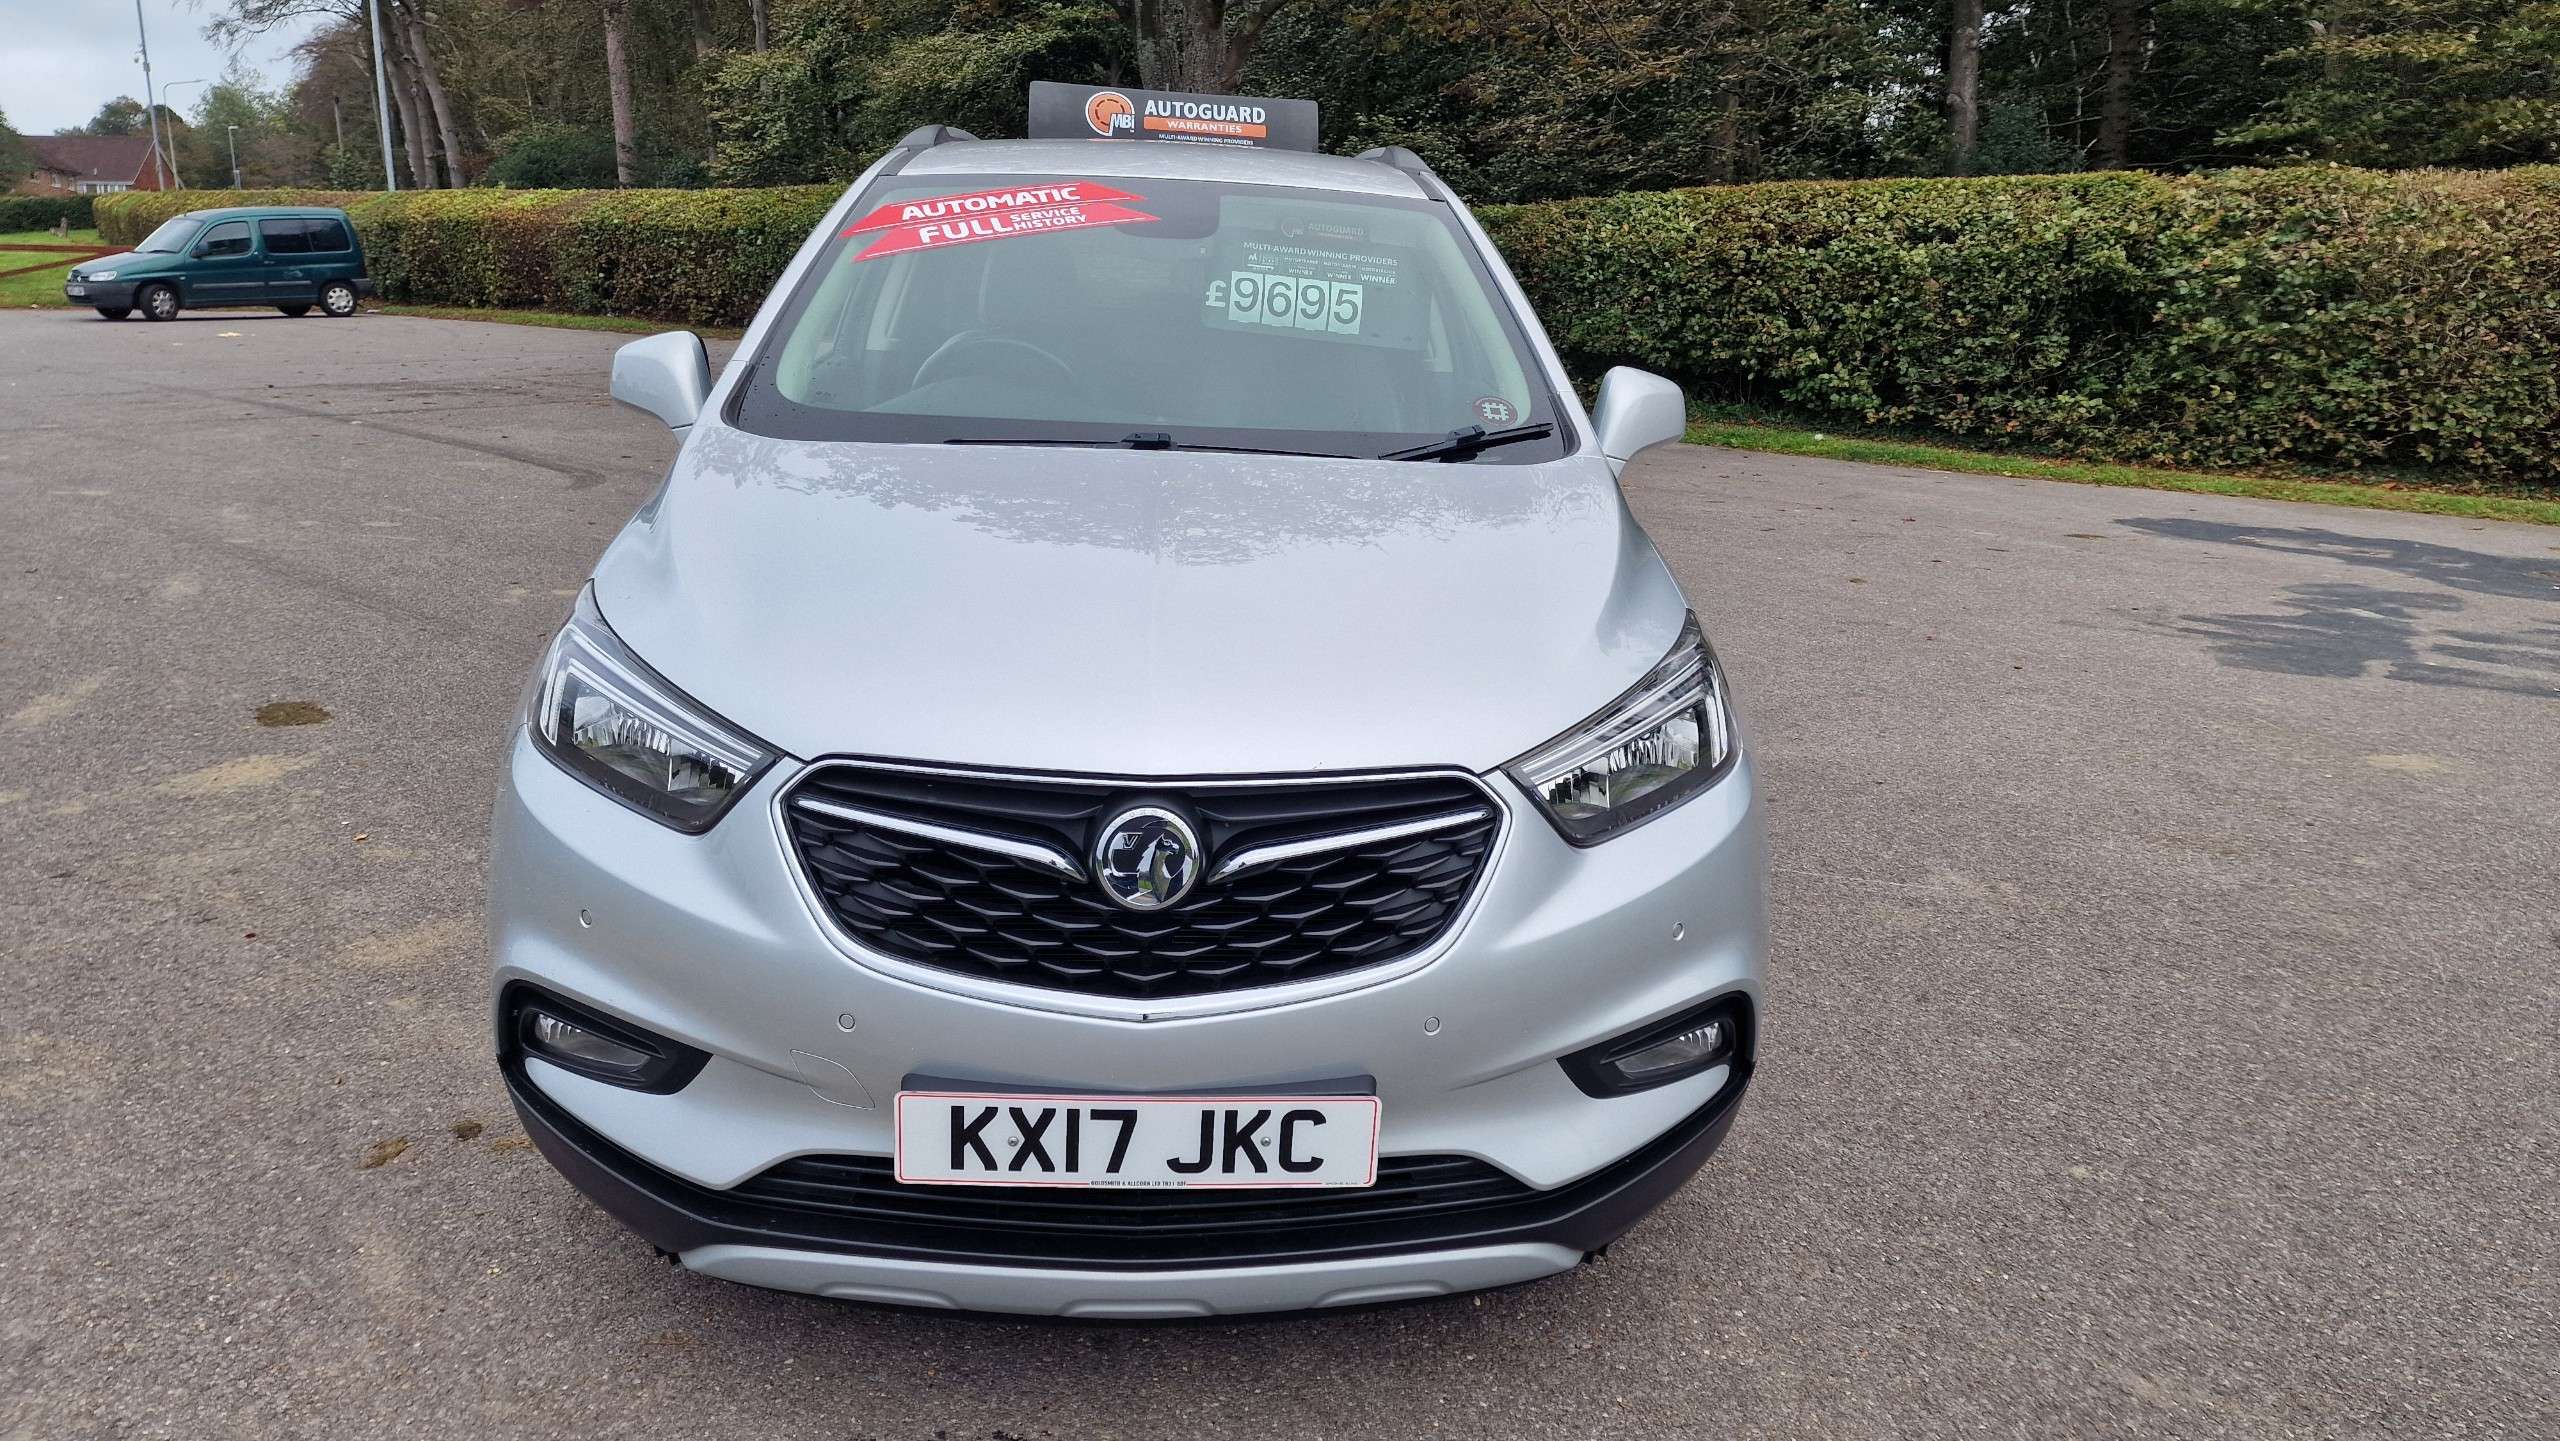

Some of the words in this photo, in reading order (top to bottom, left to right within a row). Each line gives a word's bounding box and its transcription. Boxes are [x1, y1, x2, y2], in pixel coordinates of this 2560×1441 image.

[1144, 99, 1267, 124] AUTOGUARD
[1167, 120, 1243, 134] WARRANTIES
[901, 185, 1081, 221] AUTOMATIC
[1009, 206, 1081, 223] SERVICE
[1012, 214, 1087, 232] HISTORY
[918, 217, 1014, 244] FULL
[1308, 222, 1365, 236] AUTOGUARD
[1307, 249, 1348, 260] WINNING
[1349, 253, 1398, 267] PROVIDERS
[1360, 273, 1396, 285] WINNER
[949, 1105, 1138, 1174] KX17
[1166, 1108, 1327, 1174] JKC
